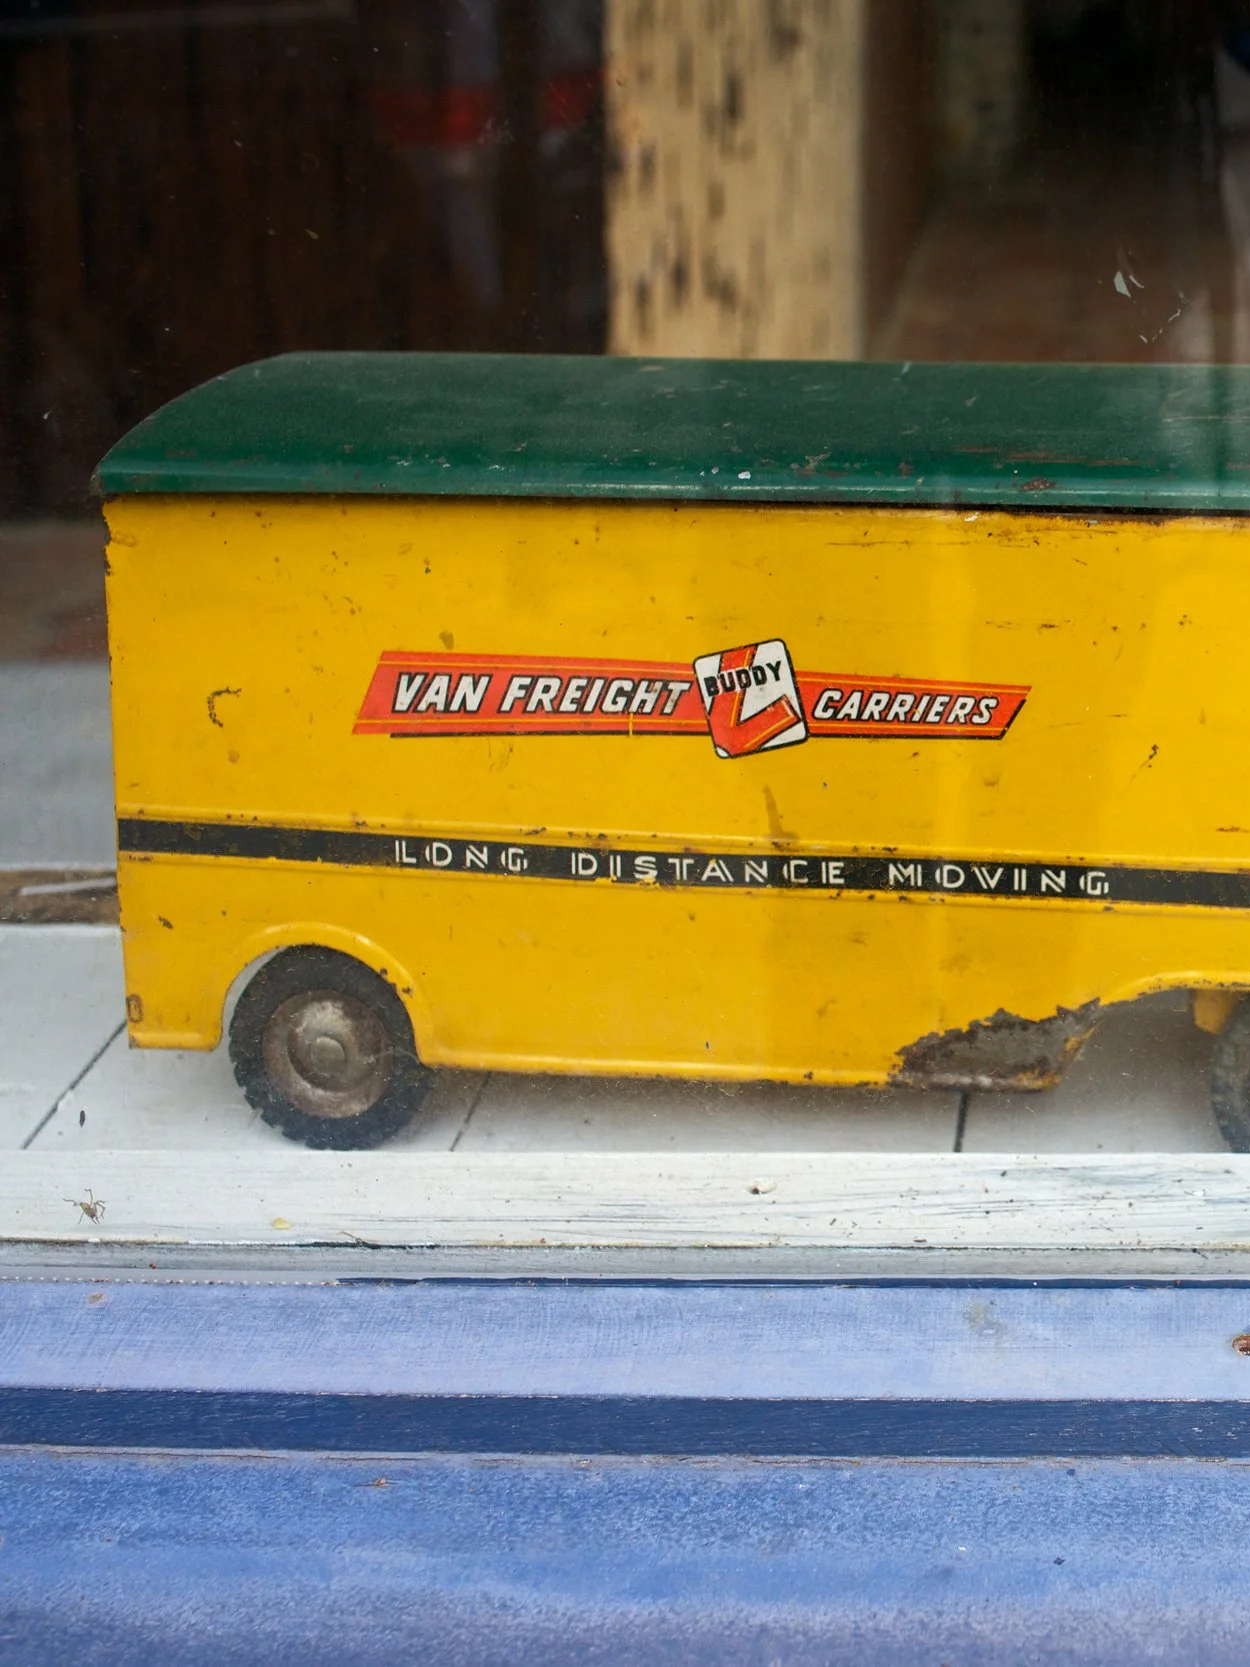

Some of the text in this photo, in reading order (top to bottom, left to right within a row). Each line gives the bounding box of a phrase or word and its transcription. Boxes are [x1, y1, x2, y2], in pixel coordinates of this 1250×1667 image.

[392, 672, 1000, 725] VAN FREIGHT CARRIERS
[703, 660, 782, 697] BUDDY
[394, 840, 1109, 895] LONG DISTANCE MOVING
